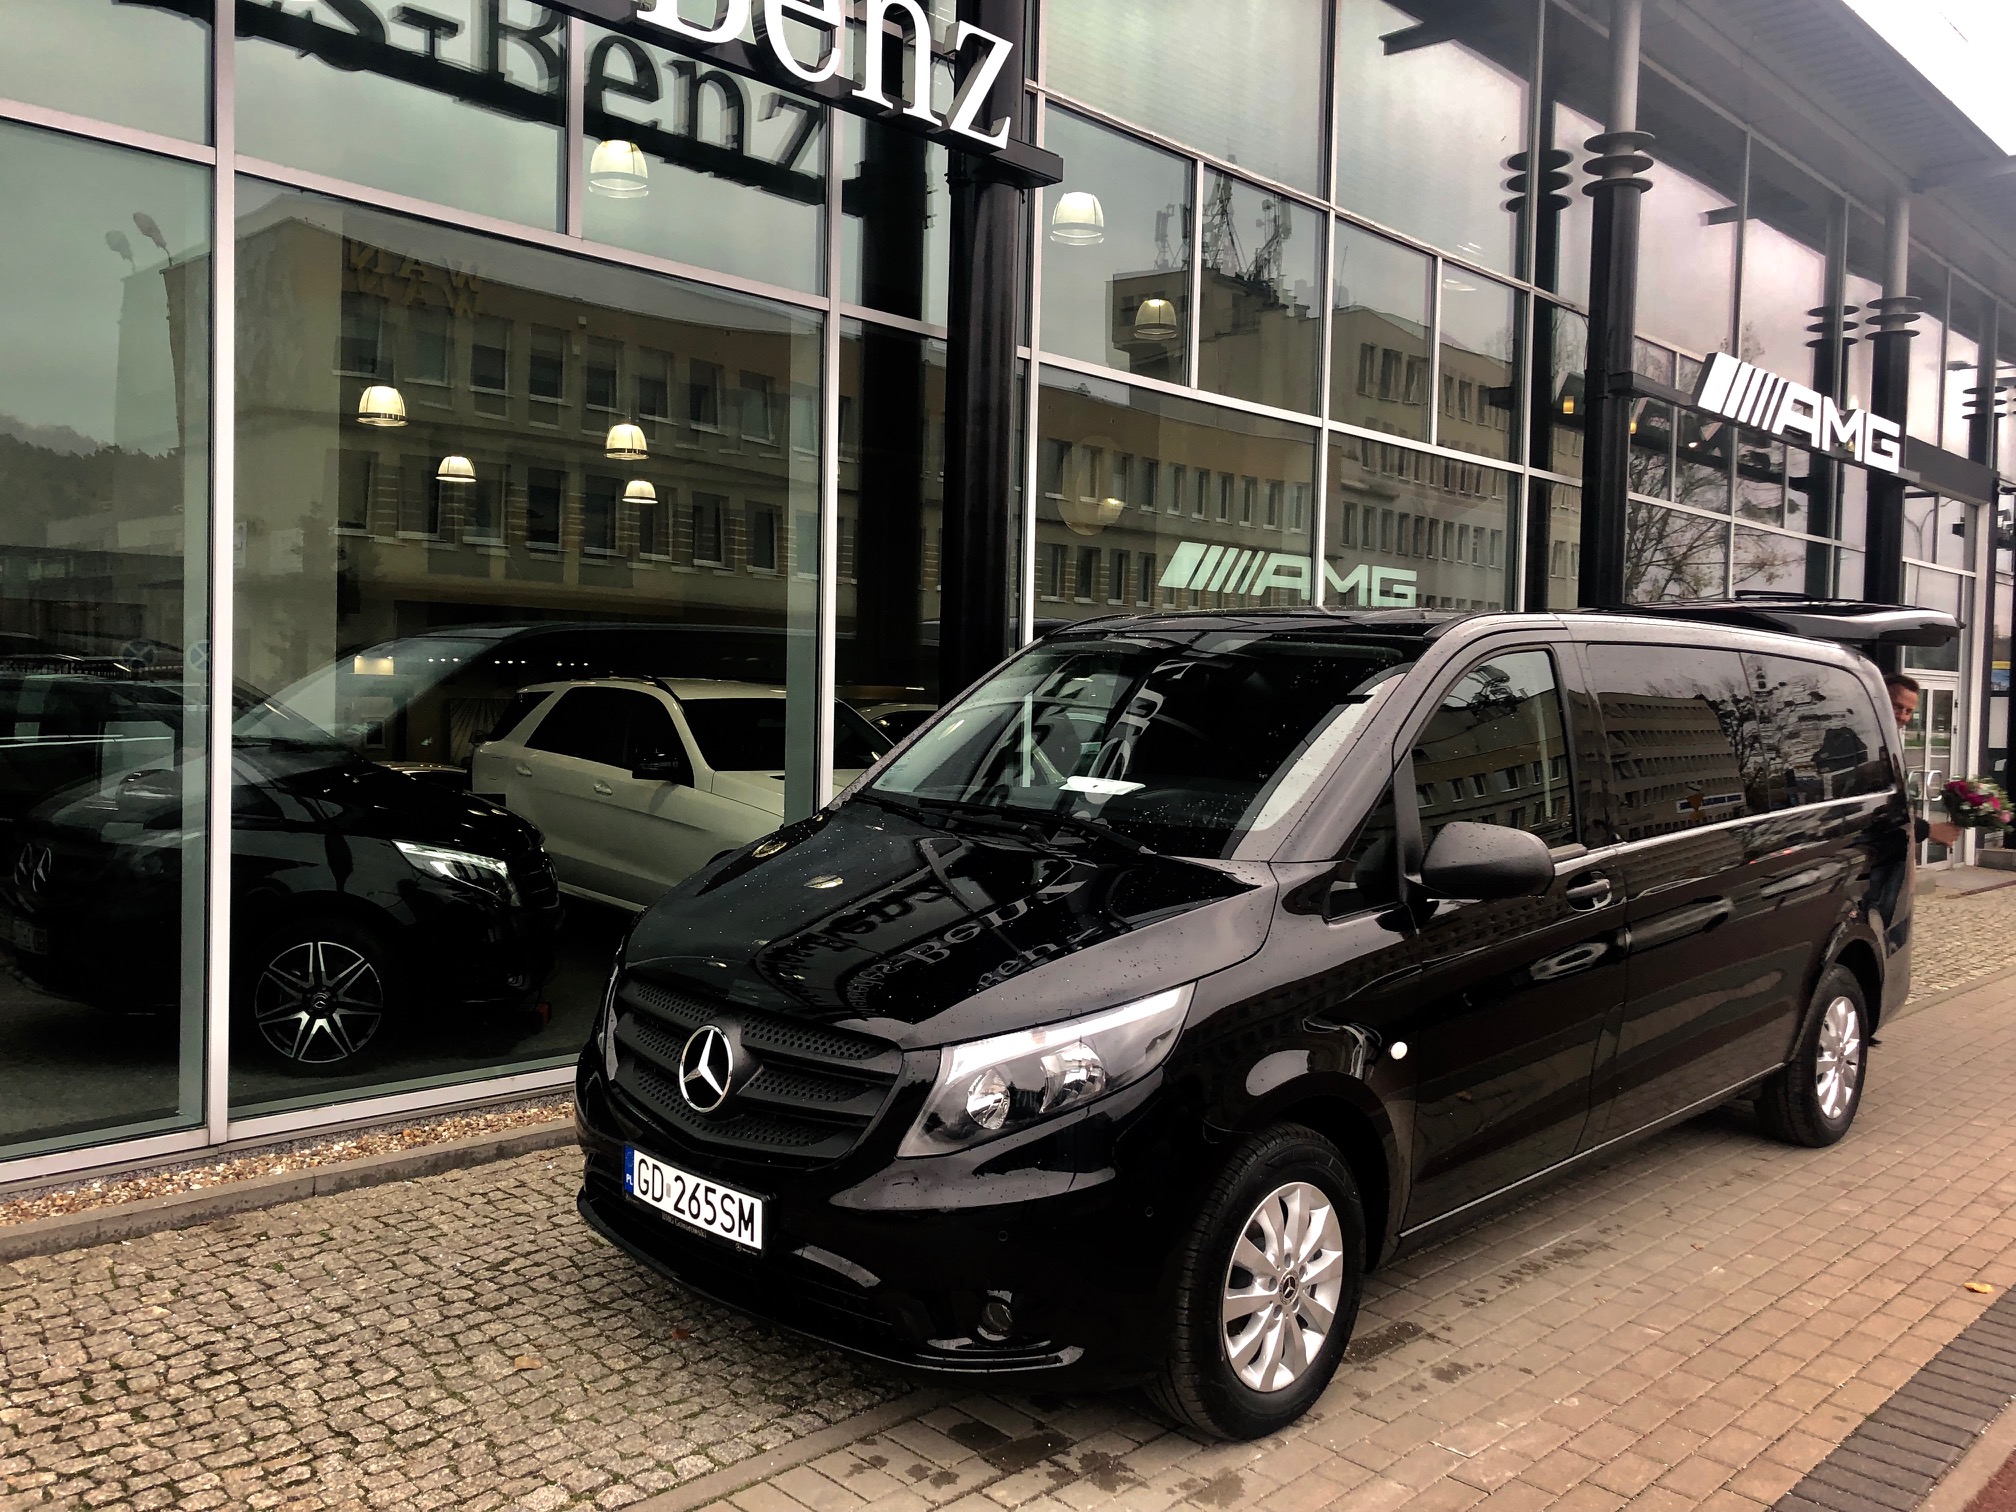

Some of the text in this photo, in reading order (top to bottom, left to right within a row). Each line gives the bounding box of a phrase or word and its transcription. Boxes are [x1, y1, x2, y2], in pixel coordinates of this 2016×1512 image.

[637, 0, 1013, 150] enz
[1772, 381, 1900, 474] AMG
[1251, 553, 1417, 607] AMG
[625, 1173, 633, 1186] PL
[637, 1158, 755, 1242] GD 265SM
